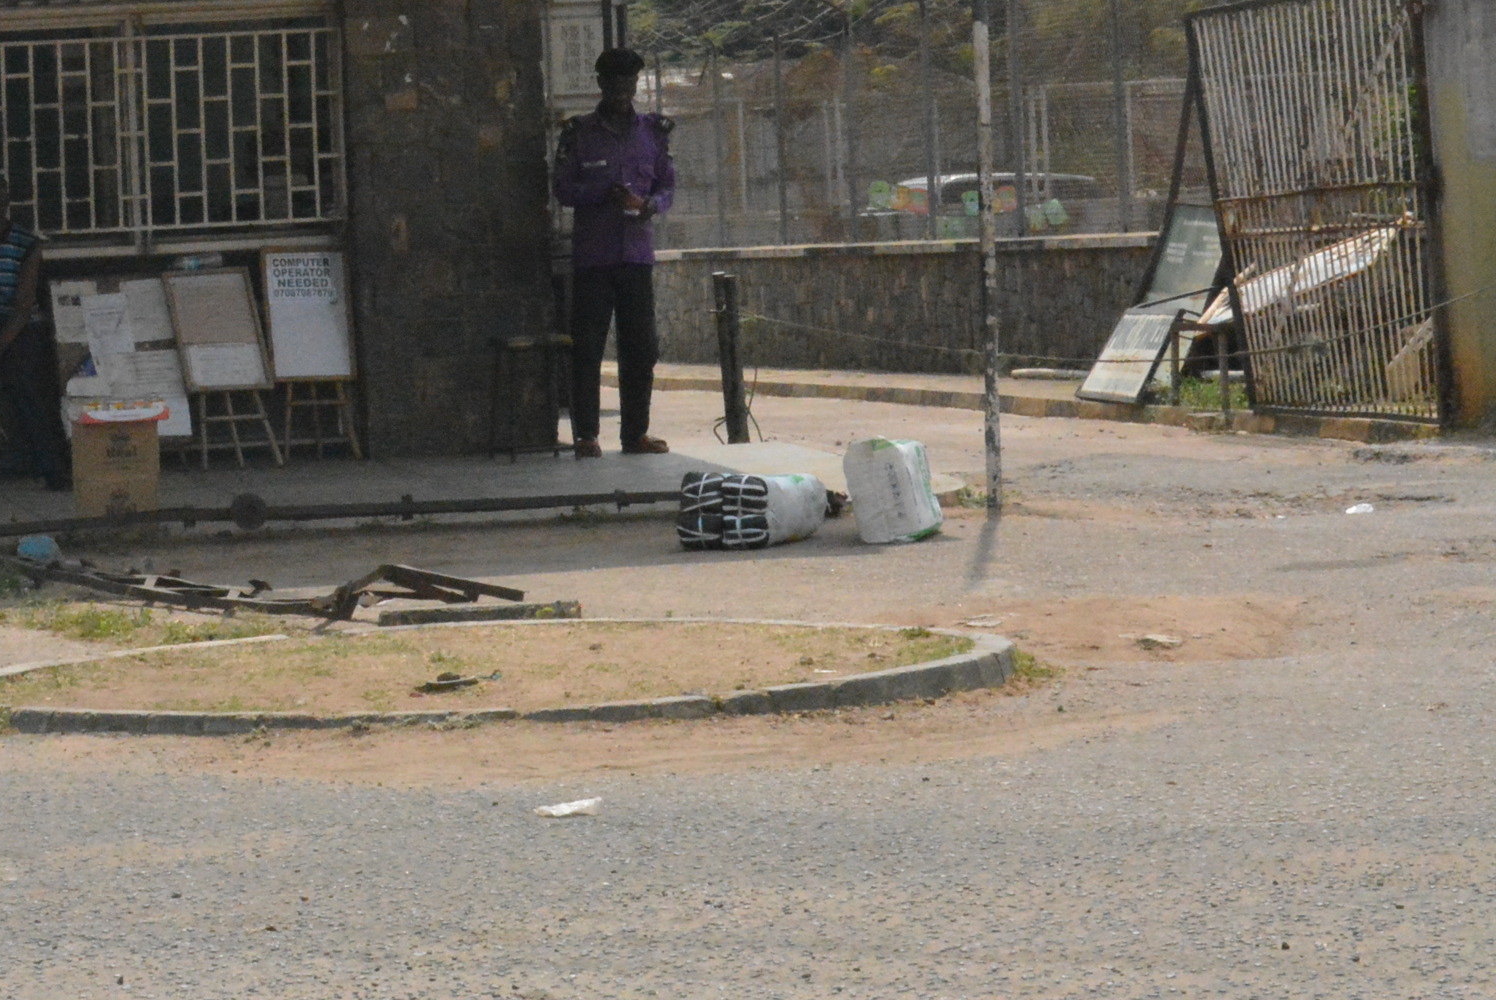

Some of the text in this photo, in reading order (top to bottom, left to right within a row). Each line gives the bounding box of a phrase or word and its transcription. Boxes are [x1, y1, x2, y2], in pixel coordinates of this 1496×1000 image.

[272, 258, 330, 267] COMPUTER
[272, 267, 330, 277] OPERATOR
[277, 278, 329, 288] NEEDED
